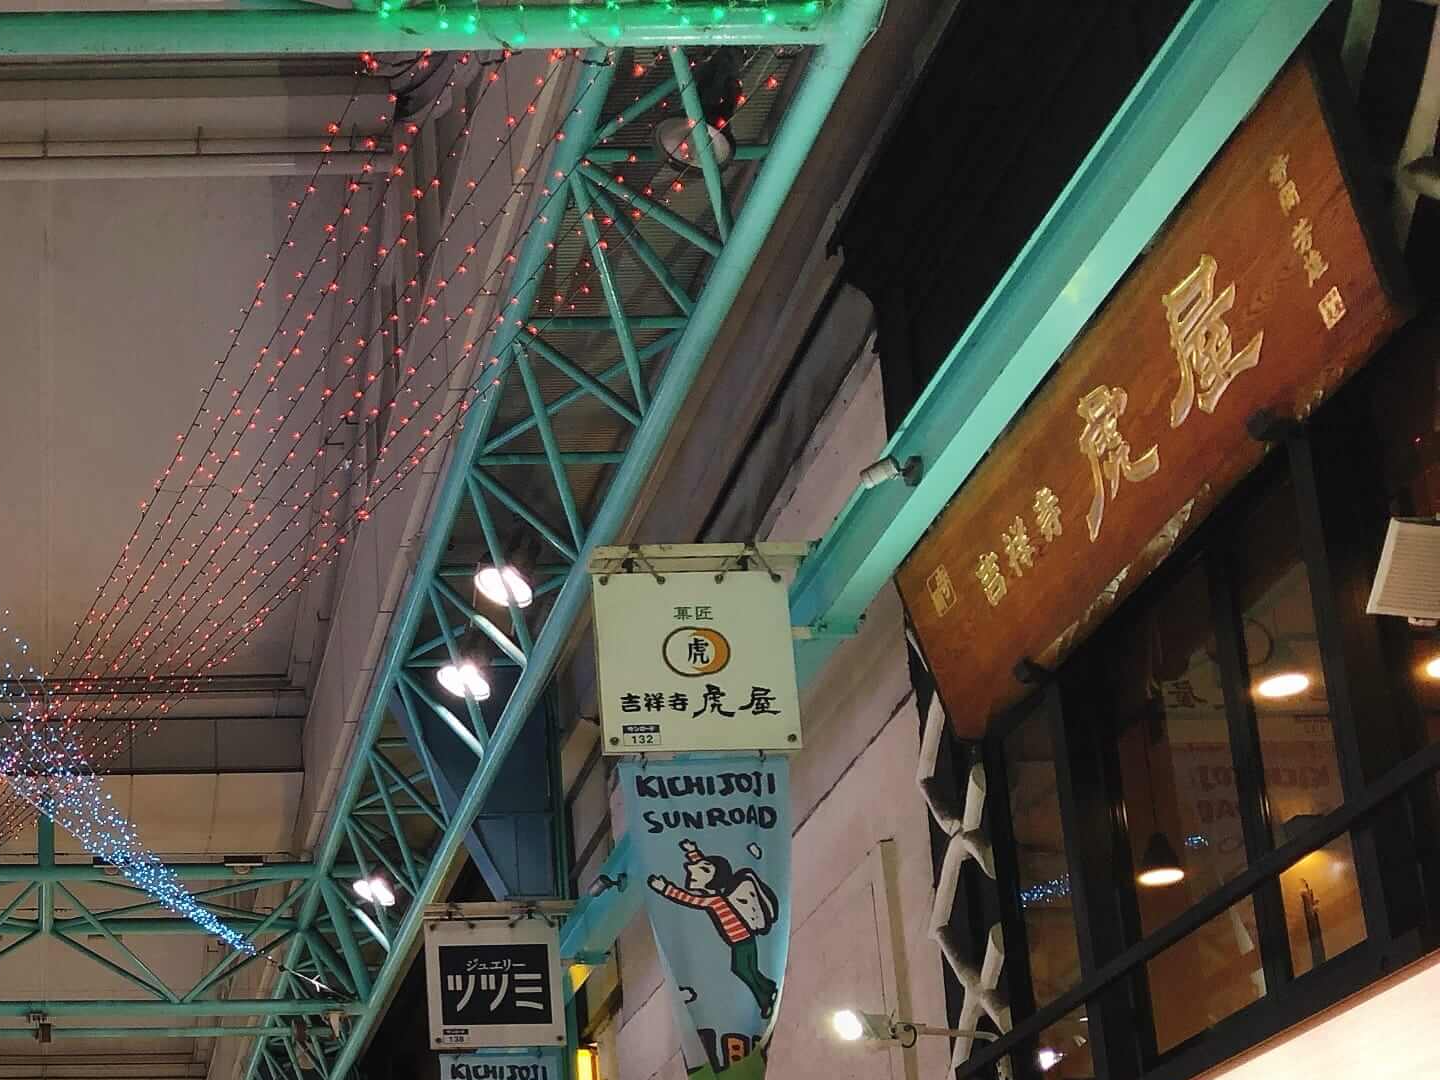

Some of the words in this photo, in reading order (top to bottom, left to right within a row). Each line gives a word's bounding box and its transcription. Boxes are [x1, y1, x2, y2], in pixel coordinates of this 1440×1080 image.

[1076, 253, 1265, 543] 虎屋
[687, 637, 710, 664] 虎
[631, 735, 654, 744] 132
[635, 771, 776, 799] KICHIJOJI
[643, 804, 778, 834] SUNROAD
[465, 959, 526, 971] ジュエリー
[447, 973, 544, 1013] ツツミ
